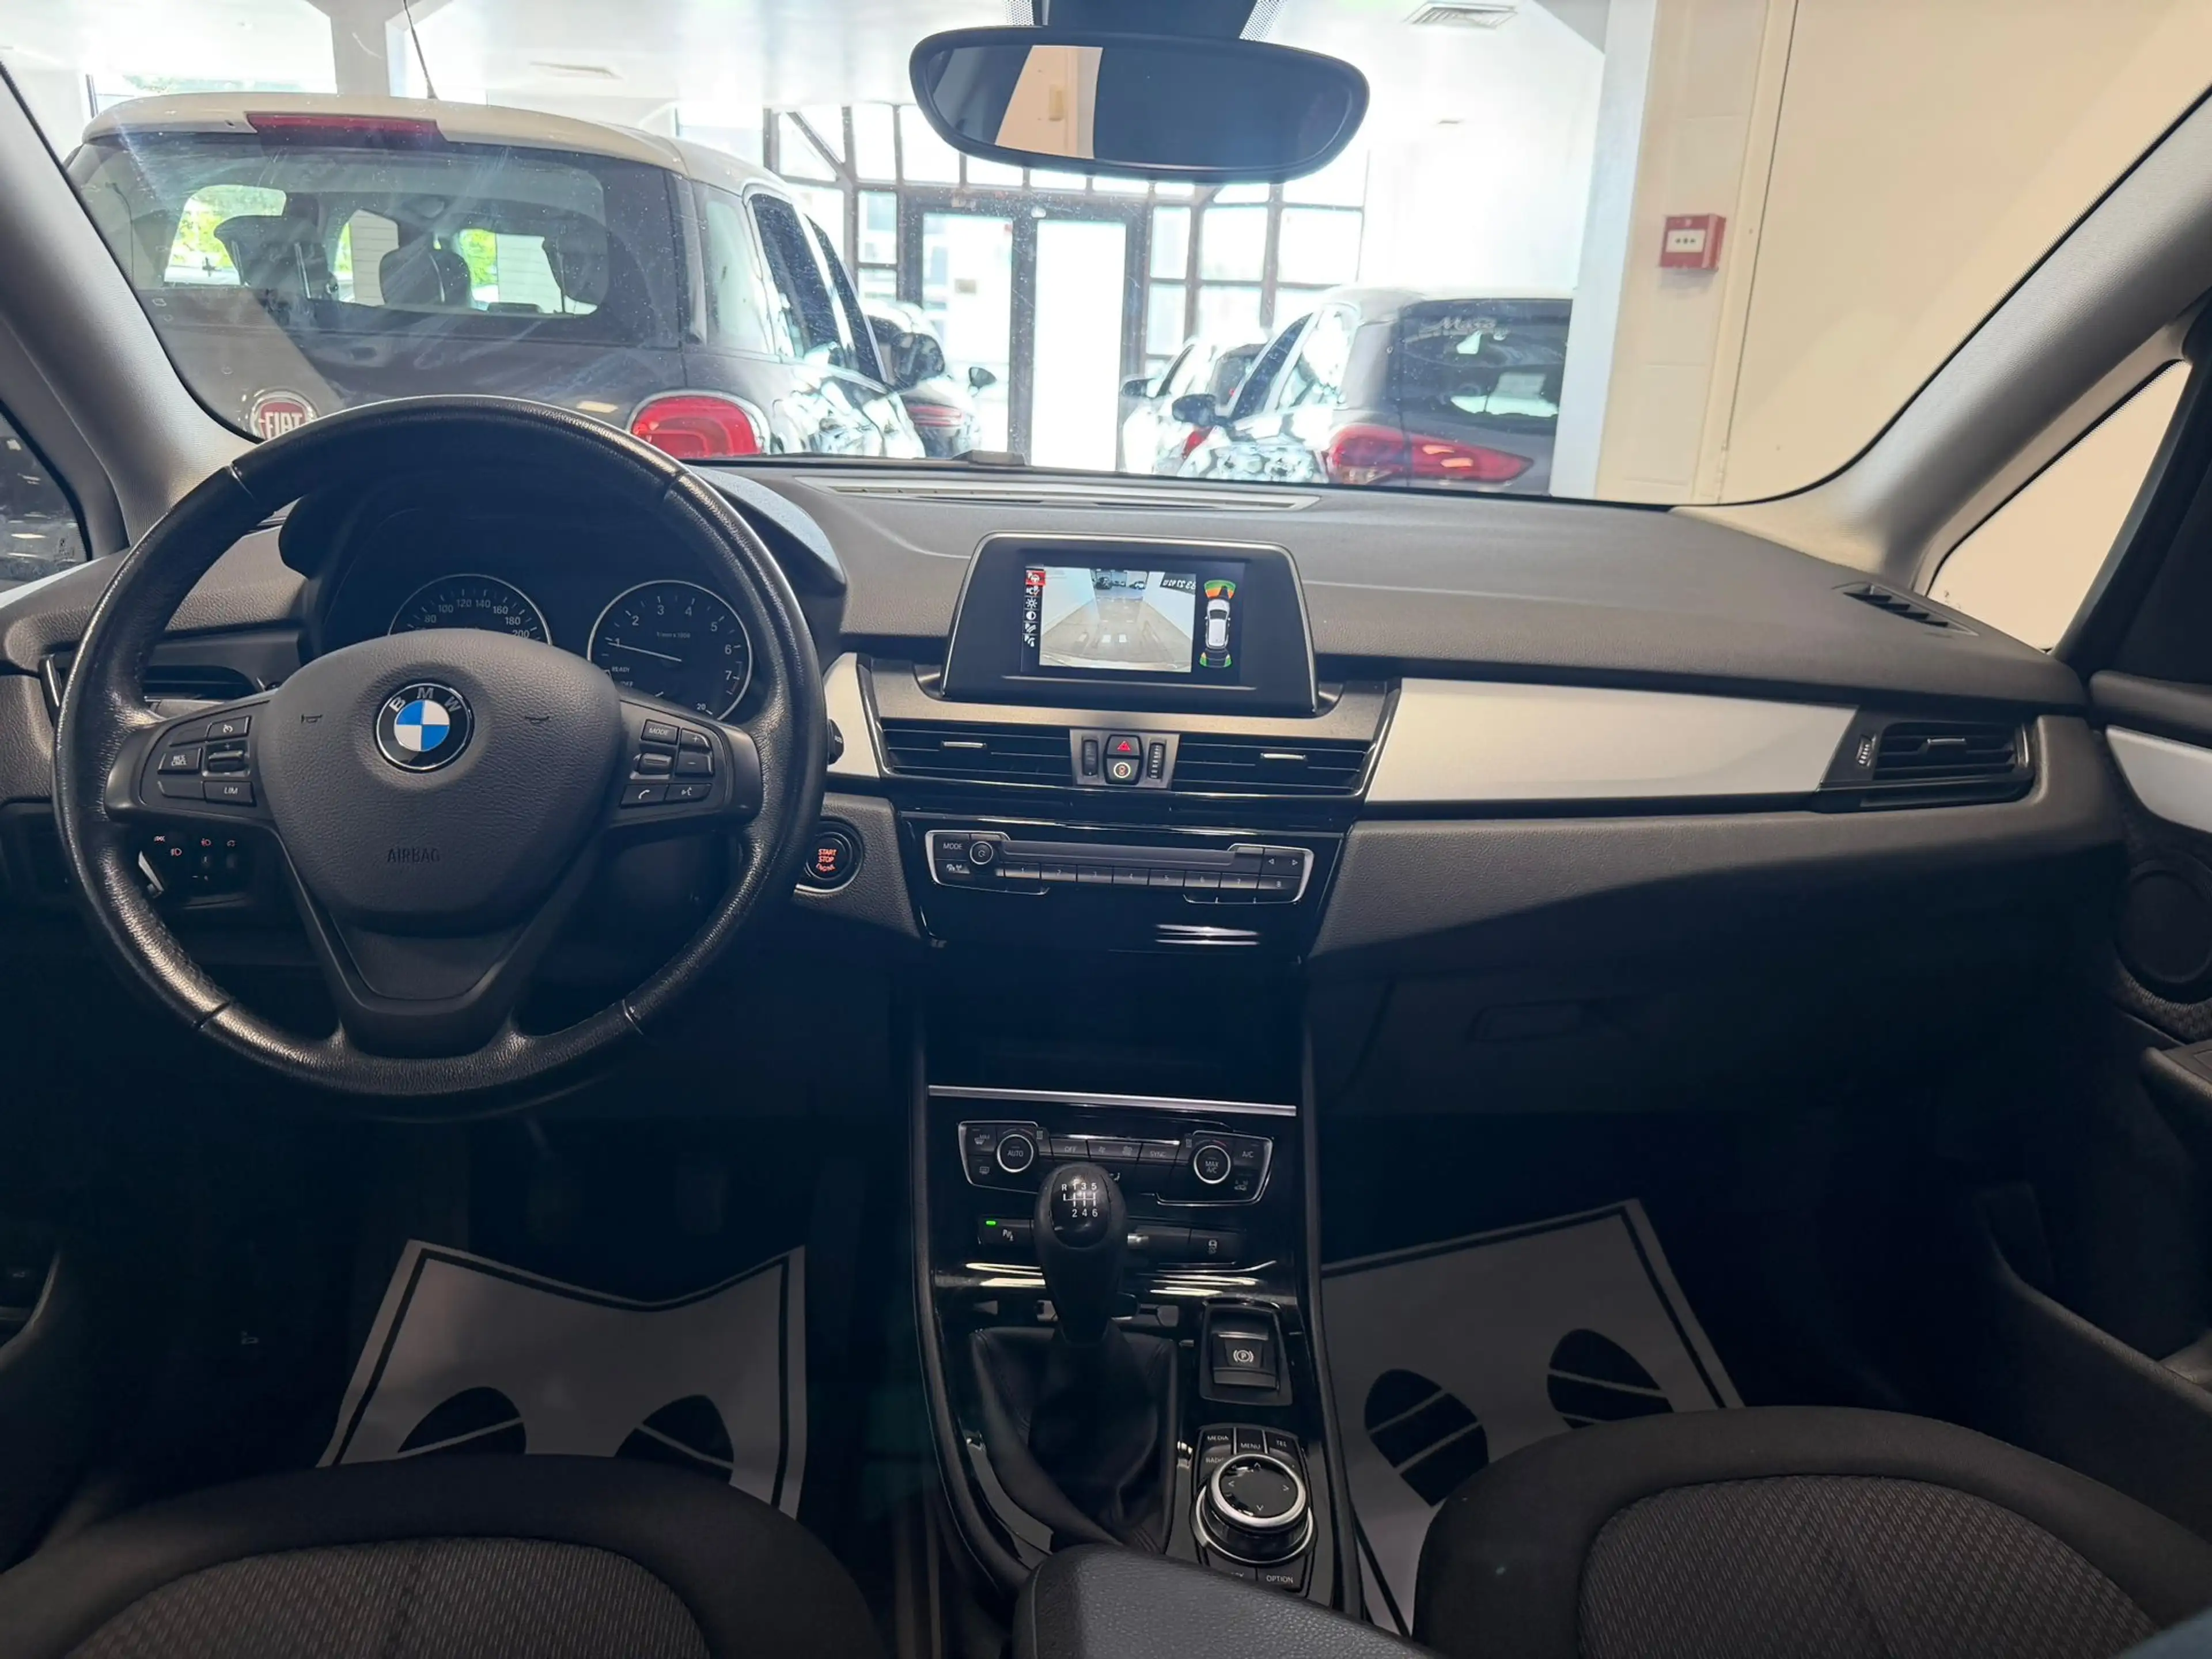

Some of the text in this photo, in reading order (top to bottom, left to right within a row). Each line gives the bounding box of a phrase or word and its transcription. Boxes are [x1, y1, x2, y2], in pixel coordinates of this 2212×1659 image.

[265, 411, 302, 440] FIAT
[456, 600, 472, 608] 120
[475, 600, 491, 608] 140
[438, 605, 453, 613] 100
[493, 606, 508, 615] 160
[658, 605, 664, 615] 3
[685, 606, 692, 616] 4
[424, 614, 437, 623] 80
[505, 617, 521, 626] 180
[632, 615, 639, 626] 2
[710, 622, 717, 631] 5
[725, 645, 732, 654] 6
[725, 671, 732, 680] 7
[389, 687, 461, 713] BMW
[649, 728, 669, 736] MODE
[224, 786, 238, 795] LIM
[943, 842, 963, 850] MODE
[387, 847, 440, 863] AIRBAG
[1072, 1209, 1098, 1218] 2 4 6
[1266, 1574, 1294, 1584] OPTION
